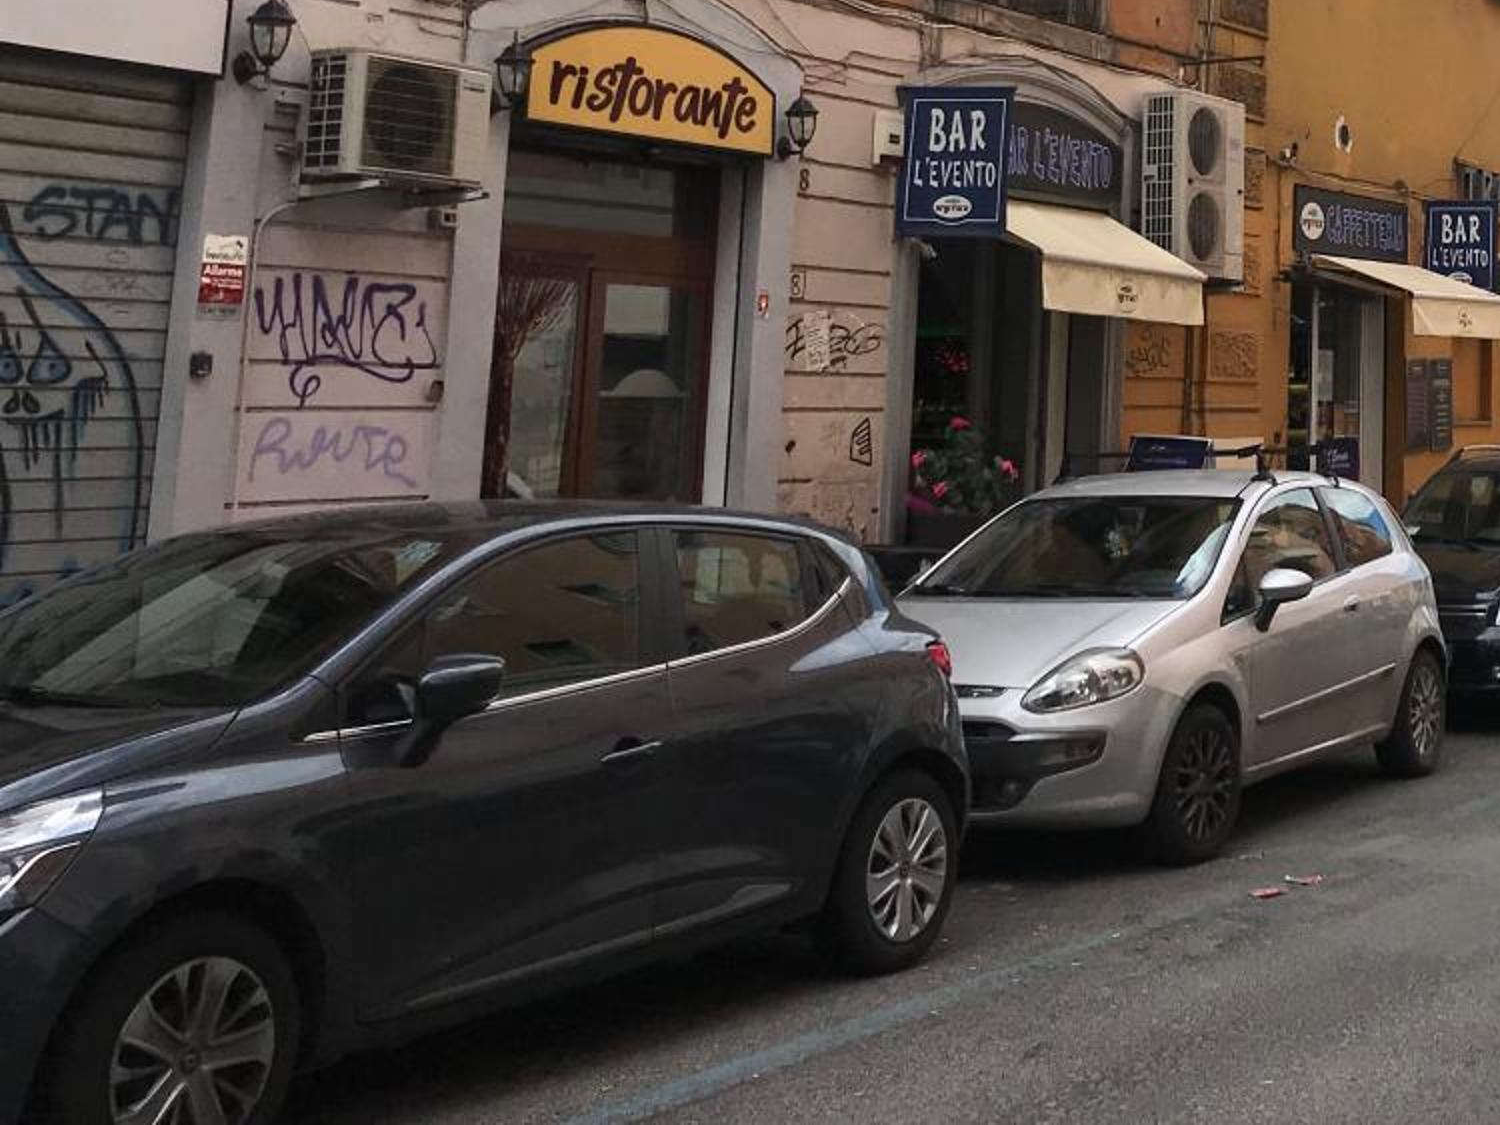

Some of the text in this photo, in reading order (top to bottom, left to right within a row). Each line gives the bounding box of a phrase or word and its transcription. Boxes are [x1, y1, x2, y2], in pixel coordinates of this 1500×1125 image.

[549, 56, 757, 140] ristorante
[928, 108, 987, 153] BAR
[913, 156, 996, 188] L'EVENTO
[1033, 128, 1113, 189] L'EVENTO
[1441, 214, 1480, 244] BAR
[1432, 246, 1488, 268] L'EVENTO
